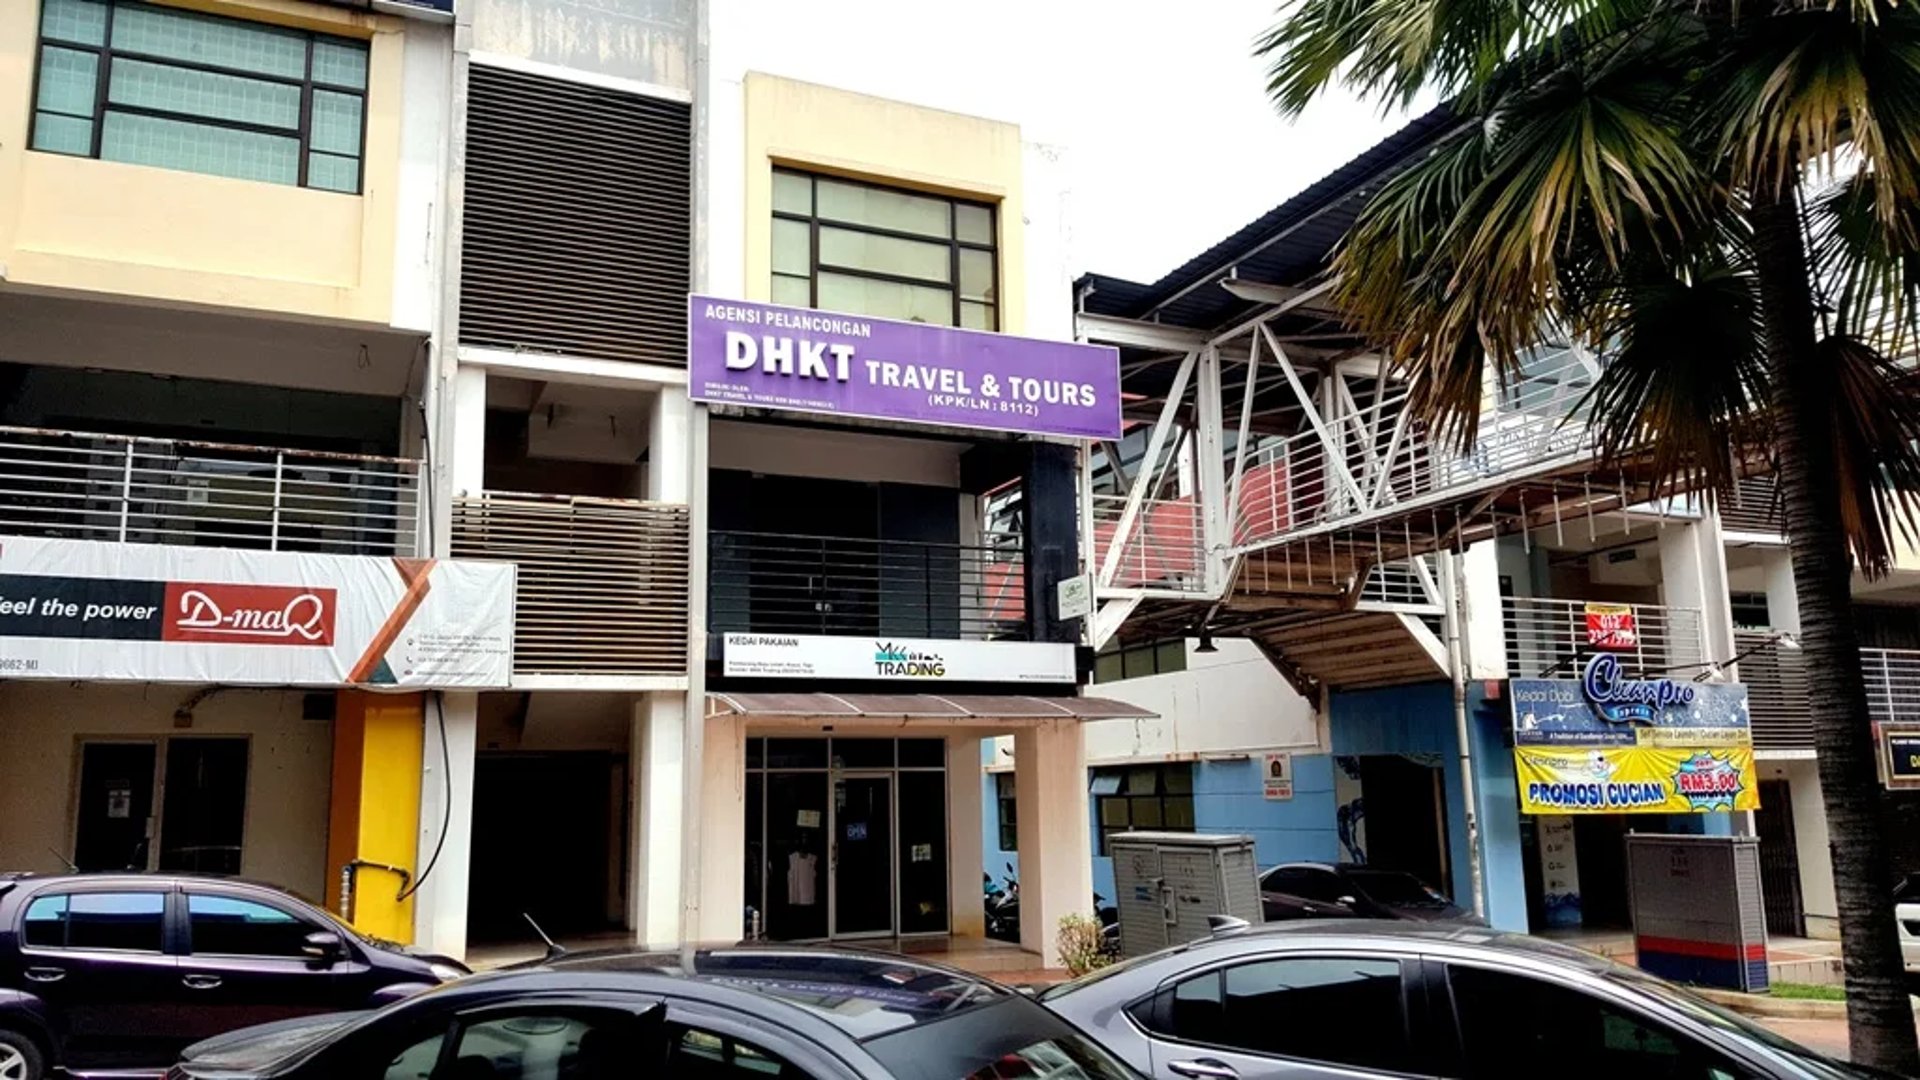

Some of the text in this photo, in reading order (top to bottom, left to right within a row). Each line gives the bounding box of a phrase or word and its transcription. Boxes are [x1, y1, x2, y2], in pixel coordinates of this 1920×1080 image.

[705, 305, 871, 338] AGENSI PELANCONGAN
[725, 331, 1096, 408] DHKT TRAVEL & TOURS
[41, 599, 78, 617] the
[83, 604, 157, 622] power
[176, 590, 323, 640] D-maQ
[729, 636, 799, 648] KEDAI PAKAIAN
[875, 661, 946, 677] TRADING
[1680, 772, 1736, 791] RM3.00
[1529, 782, 1665, 806] PROMOSI CUCIAN
